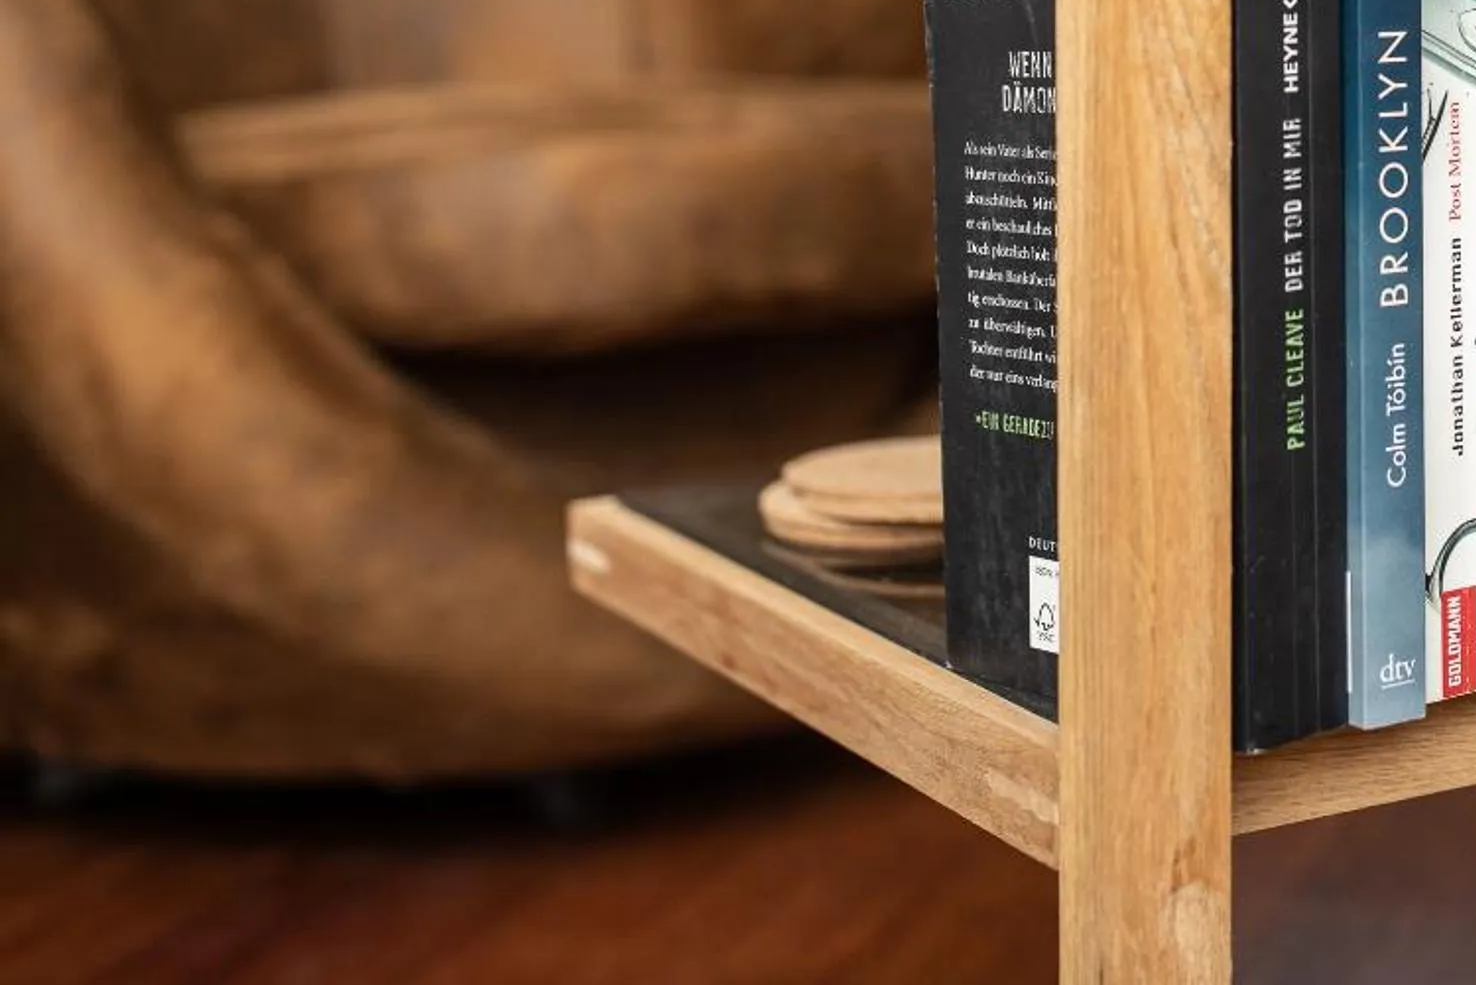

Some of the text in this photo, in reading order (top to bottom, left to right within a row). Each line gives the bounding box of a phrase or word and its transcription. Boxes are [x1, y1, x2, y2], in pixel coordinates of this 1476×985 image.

[1008, 51, 1052, 78] WENN
[1283, 12, 1299, 93] HEYNE
[1282, 117, 1304, 293] DER TOD IN MIR
[1378, 30, 1409, 307] BROOKLYN
[1448, 102, 1462, 222] Post Mortem
[1285, 309, 1306, 450] PAUL CLEAVE
[1450, 238, 1463, 457] Jonathan Kellerman
[1385, 343, 1406, 488] Colm Tóibín
[1379, 653, 1417, 683] dtv
[1447, 595, 1462, 687] GOLDMANN
